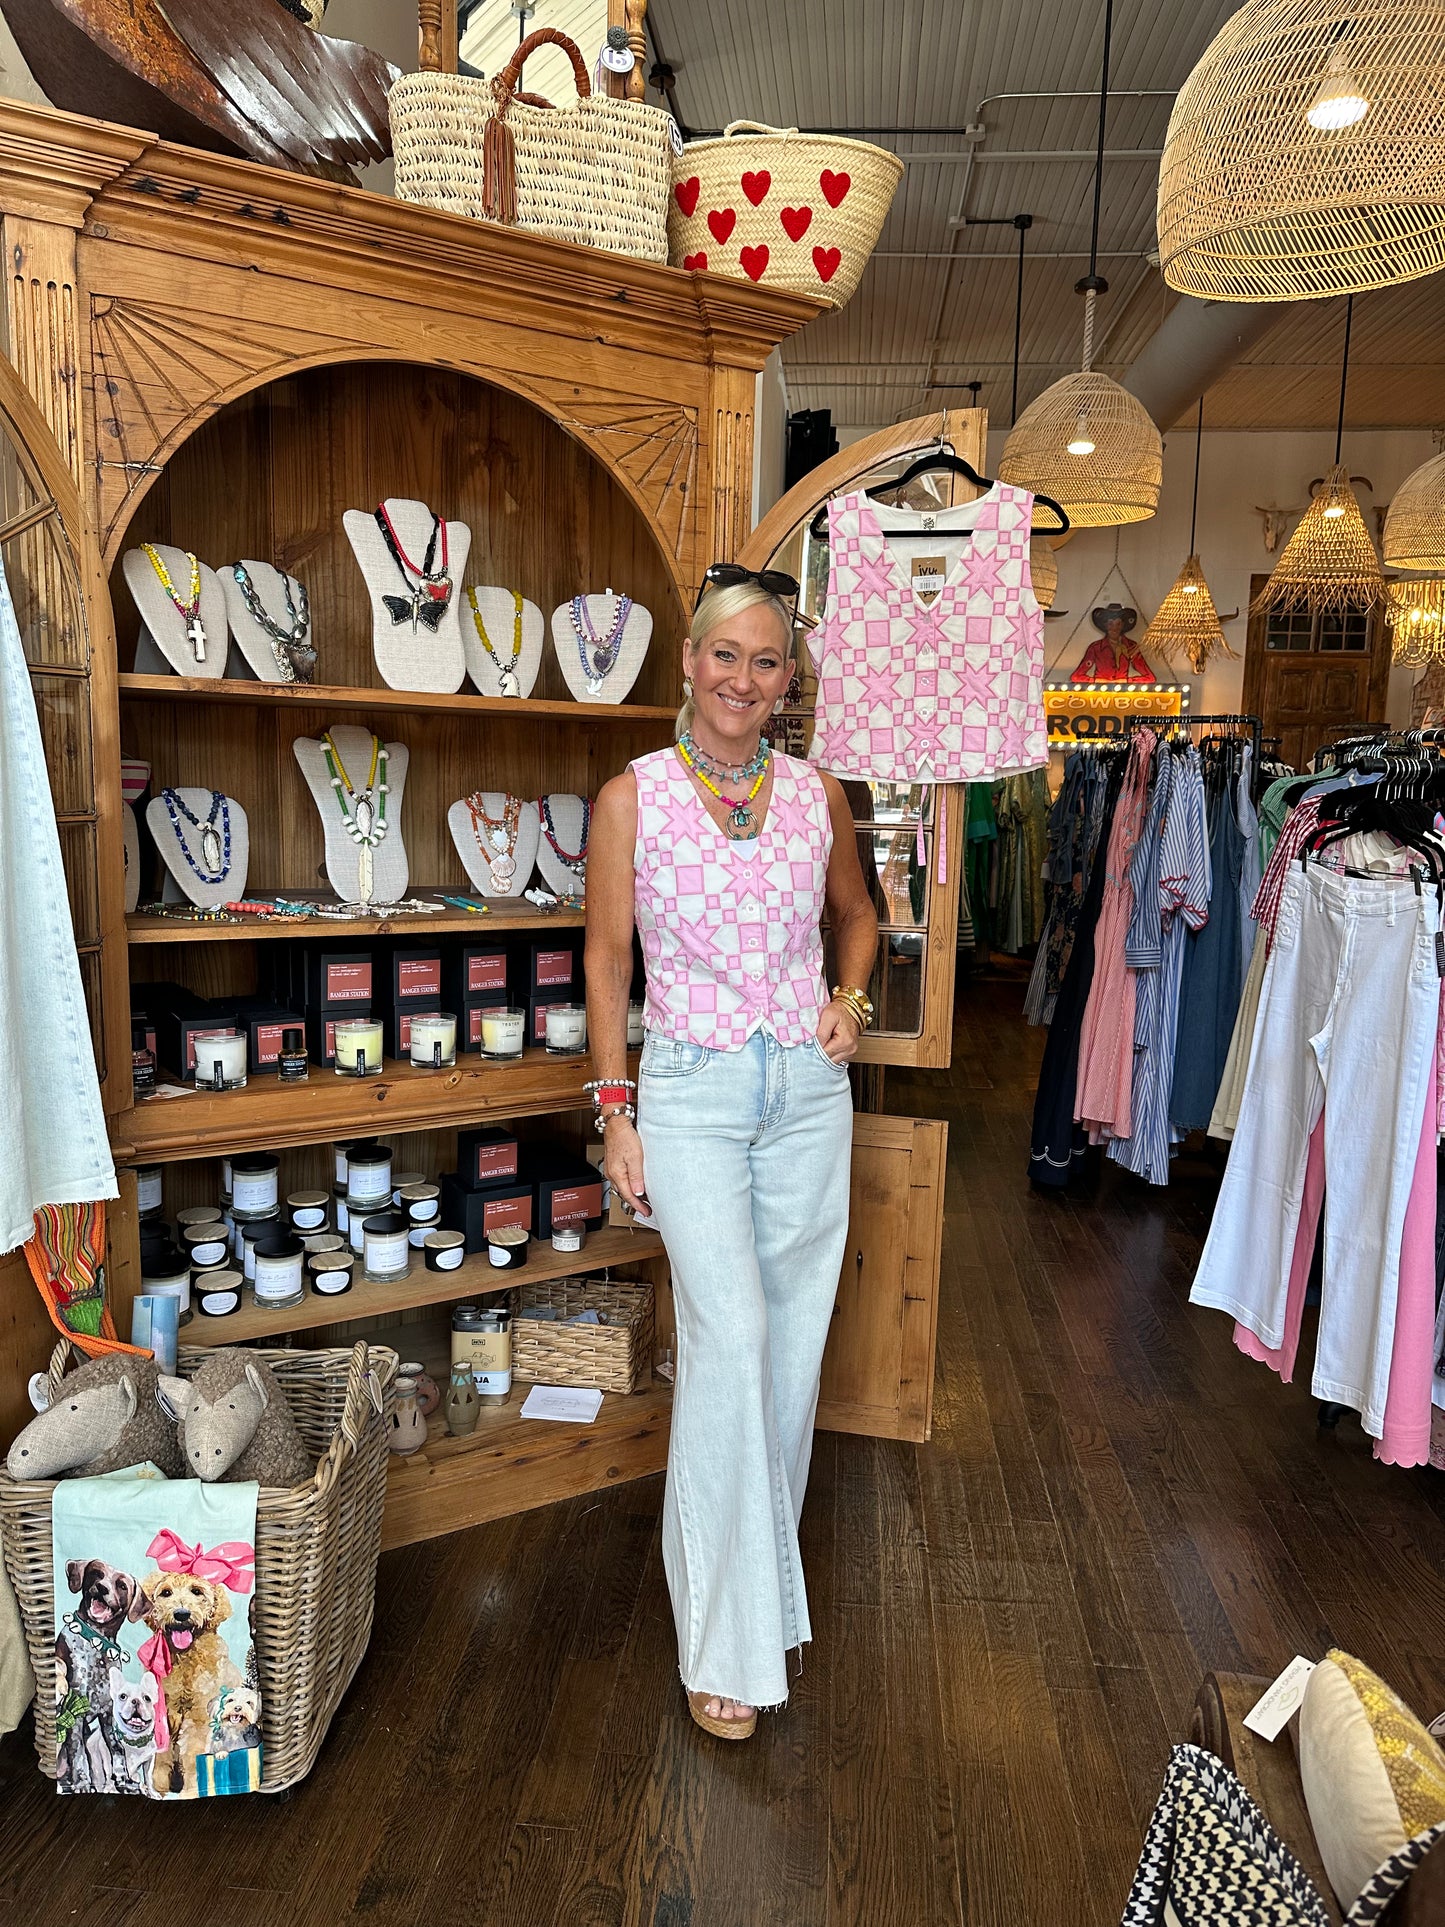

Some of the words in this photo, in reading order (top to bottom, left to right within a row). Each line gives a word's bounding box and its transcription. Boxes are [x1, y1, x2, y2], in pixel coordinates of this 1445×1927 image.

[1048, 695, 1175, 710] COWBOY
[1047, 715, 1132, 736] ROD
[261, 1053, 279, 1061] RANGE
[473, 1376, 489, 1384] AJA
